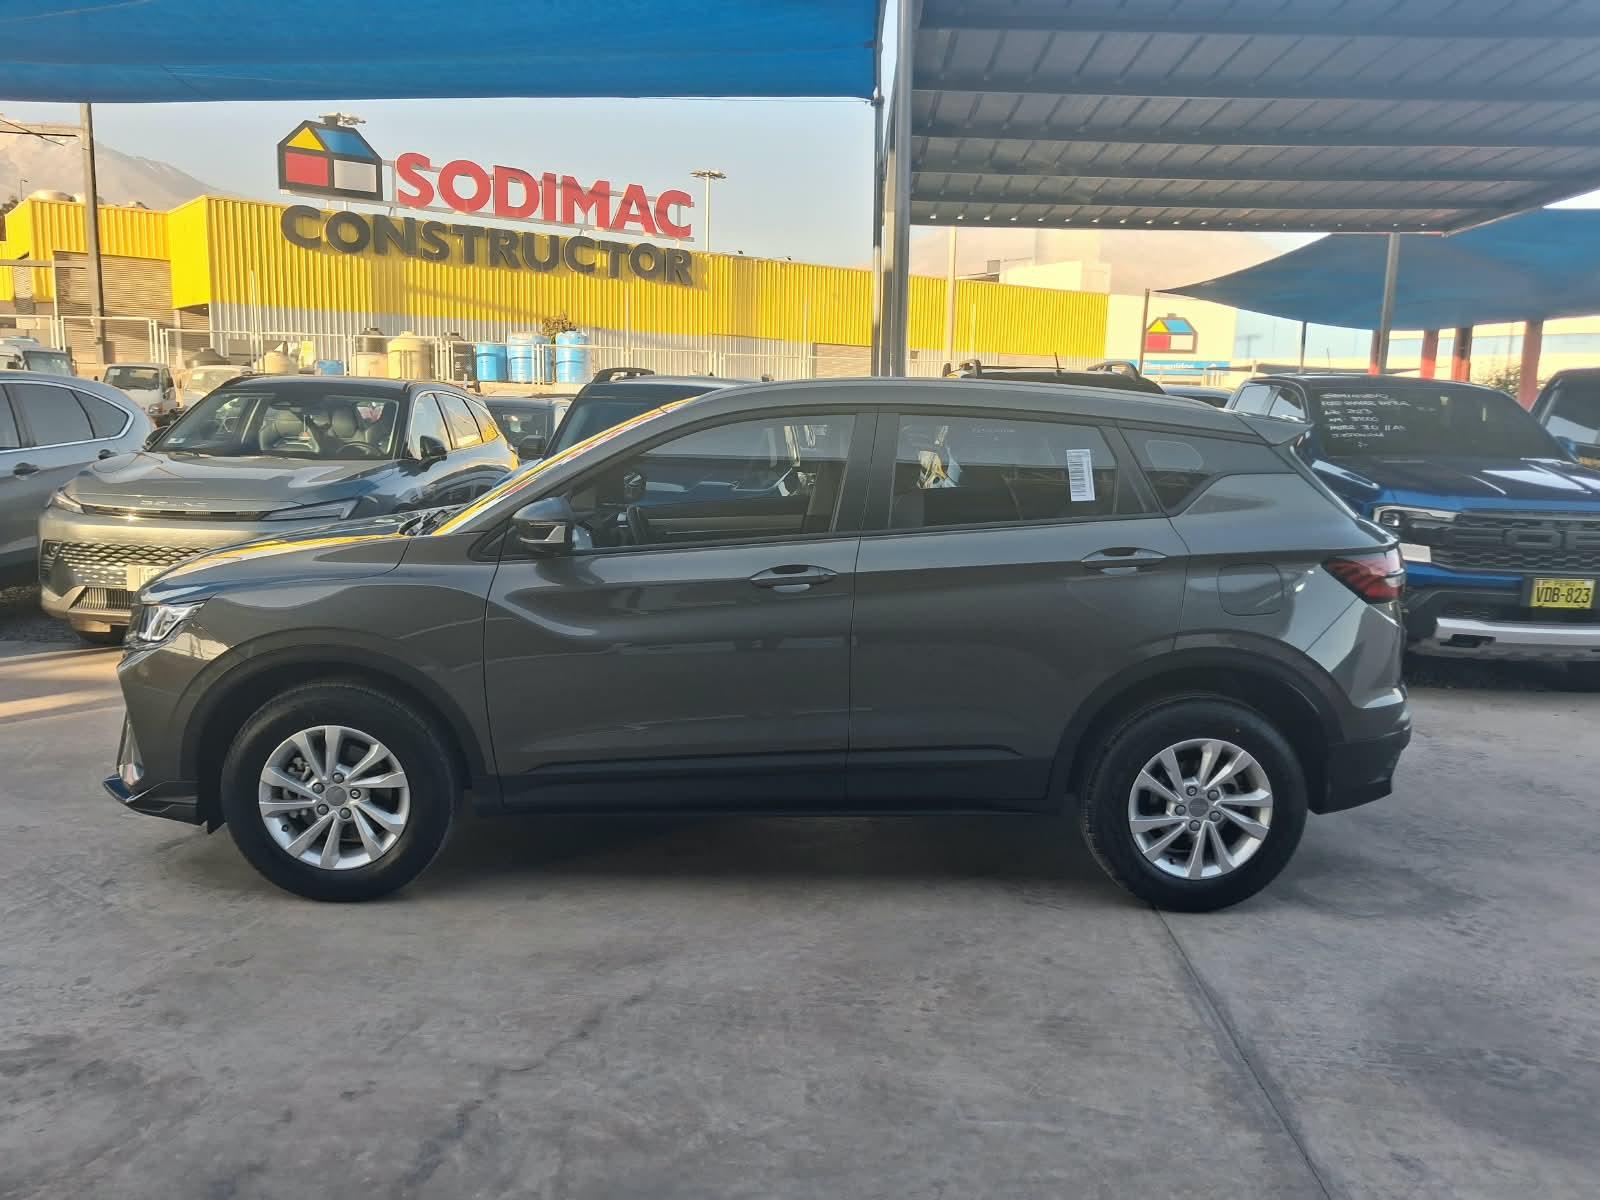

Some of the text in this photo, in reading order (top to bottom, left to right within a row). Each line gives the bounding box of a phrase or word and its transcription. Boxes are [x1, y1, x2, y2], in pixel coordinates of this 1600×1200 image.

[395, 152, 693, 239] SODIMAC
[280, 204, 693, 286] CONSTRUCTOR
[1536, 586, 1592, 604] VDB-823
